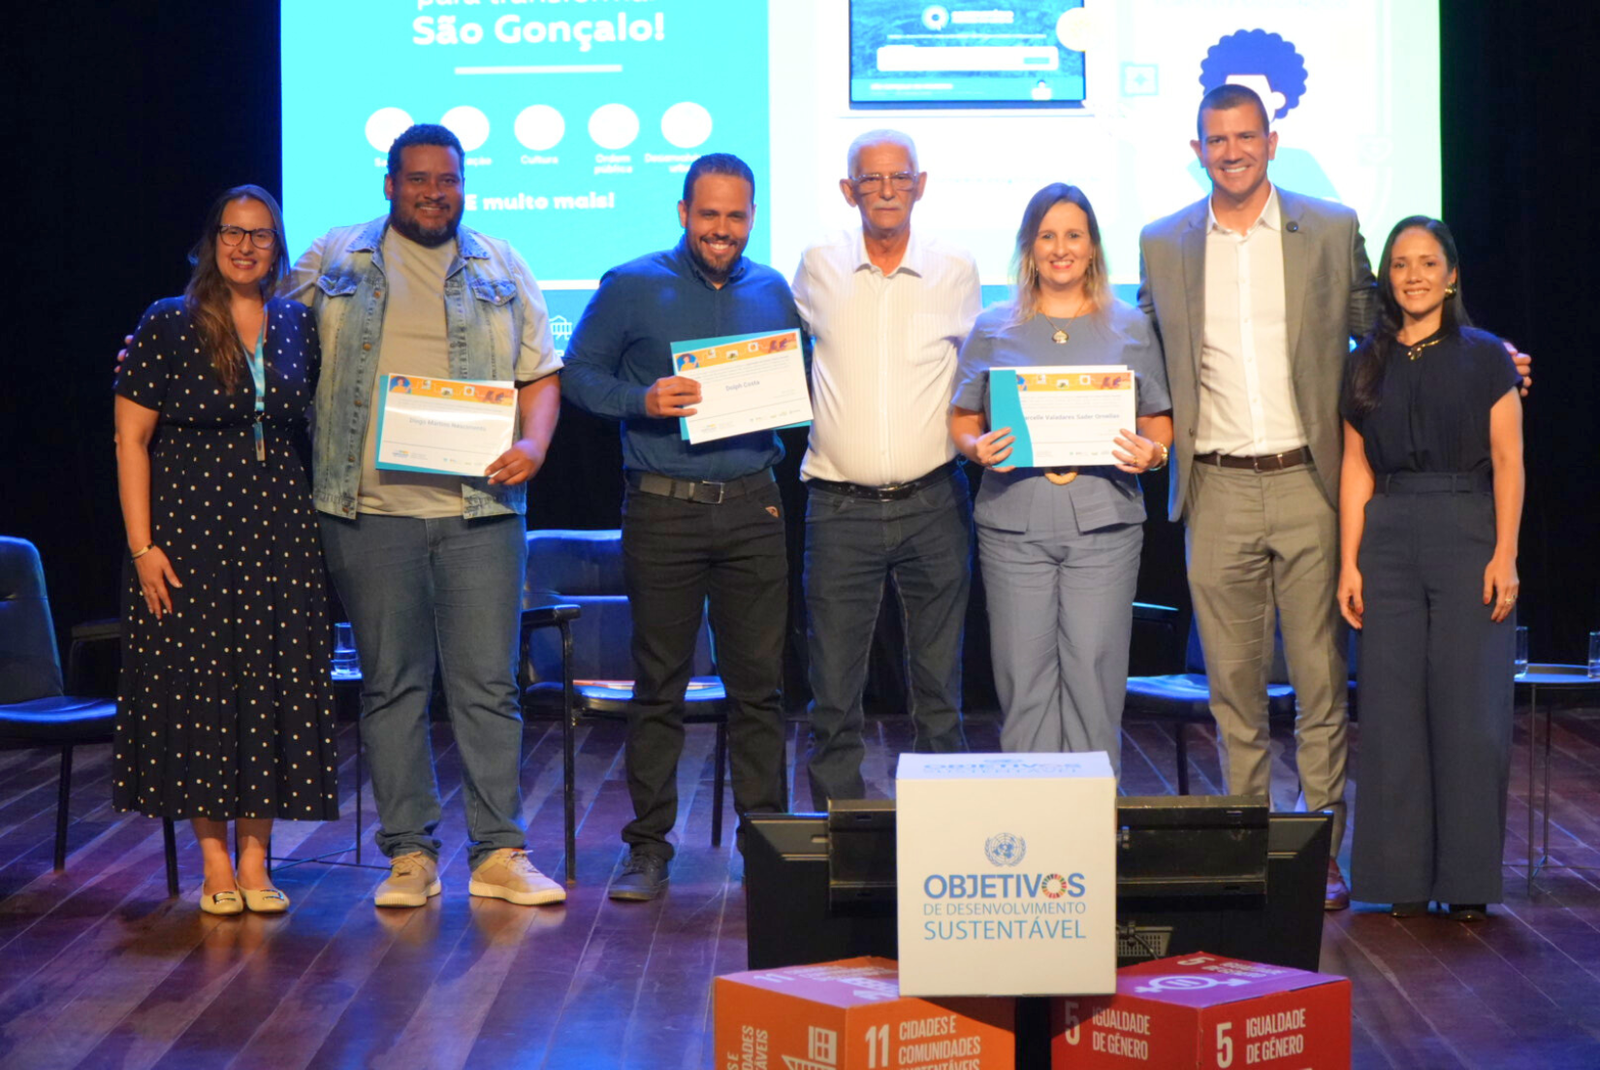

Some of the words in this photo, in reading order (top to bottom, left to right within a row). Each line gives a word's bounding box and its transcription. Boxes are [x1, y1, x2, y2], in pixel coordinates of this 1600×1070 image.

[412, 15, 484, 45] São
[494, 12, 665, 52] Gonçalo!
[482, 192, 549, 211] muito
[552, 191, 616, 210] mais!
[923, 873, 1086, 899] OBJETIVOS
[923, 903, 942, 916] DE
[947, 901, 1086, 916] DESENVOLVIMENTO
[924, 916, 1087, 940] SUSTENTÁVEL
[899, 1016, 949, 1041] CIDADES
[949, 1014, 957, 1034] E
[1064, 1000, 1081, 1046] 5
[1092, 1006, 1151, 1036] IGUALDADE
[1246, 1008, 1307, 1039] IGUALDADE
[865, 1023, 890, 1069] 11
[898, 1035, 981, 1065] COMUNIDADES
[1092, 1030, 1106, 1053] DE
[1216, 1021, 1233, 1069] 5
[1246, 1042, 1261, 1065] DE
